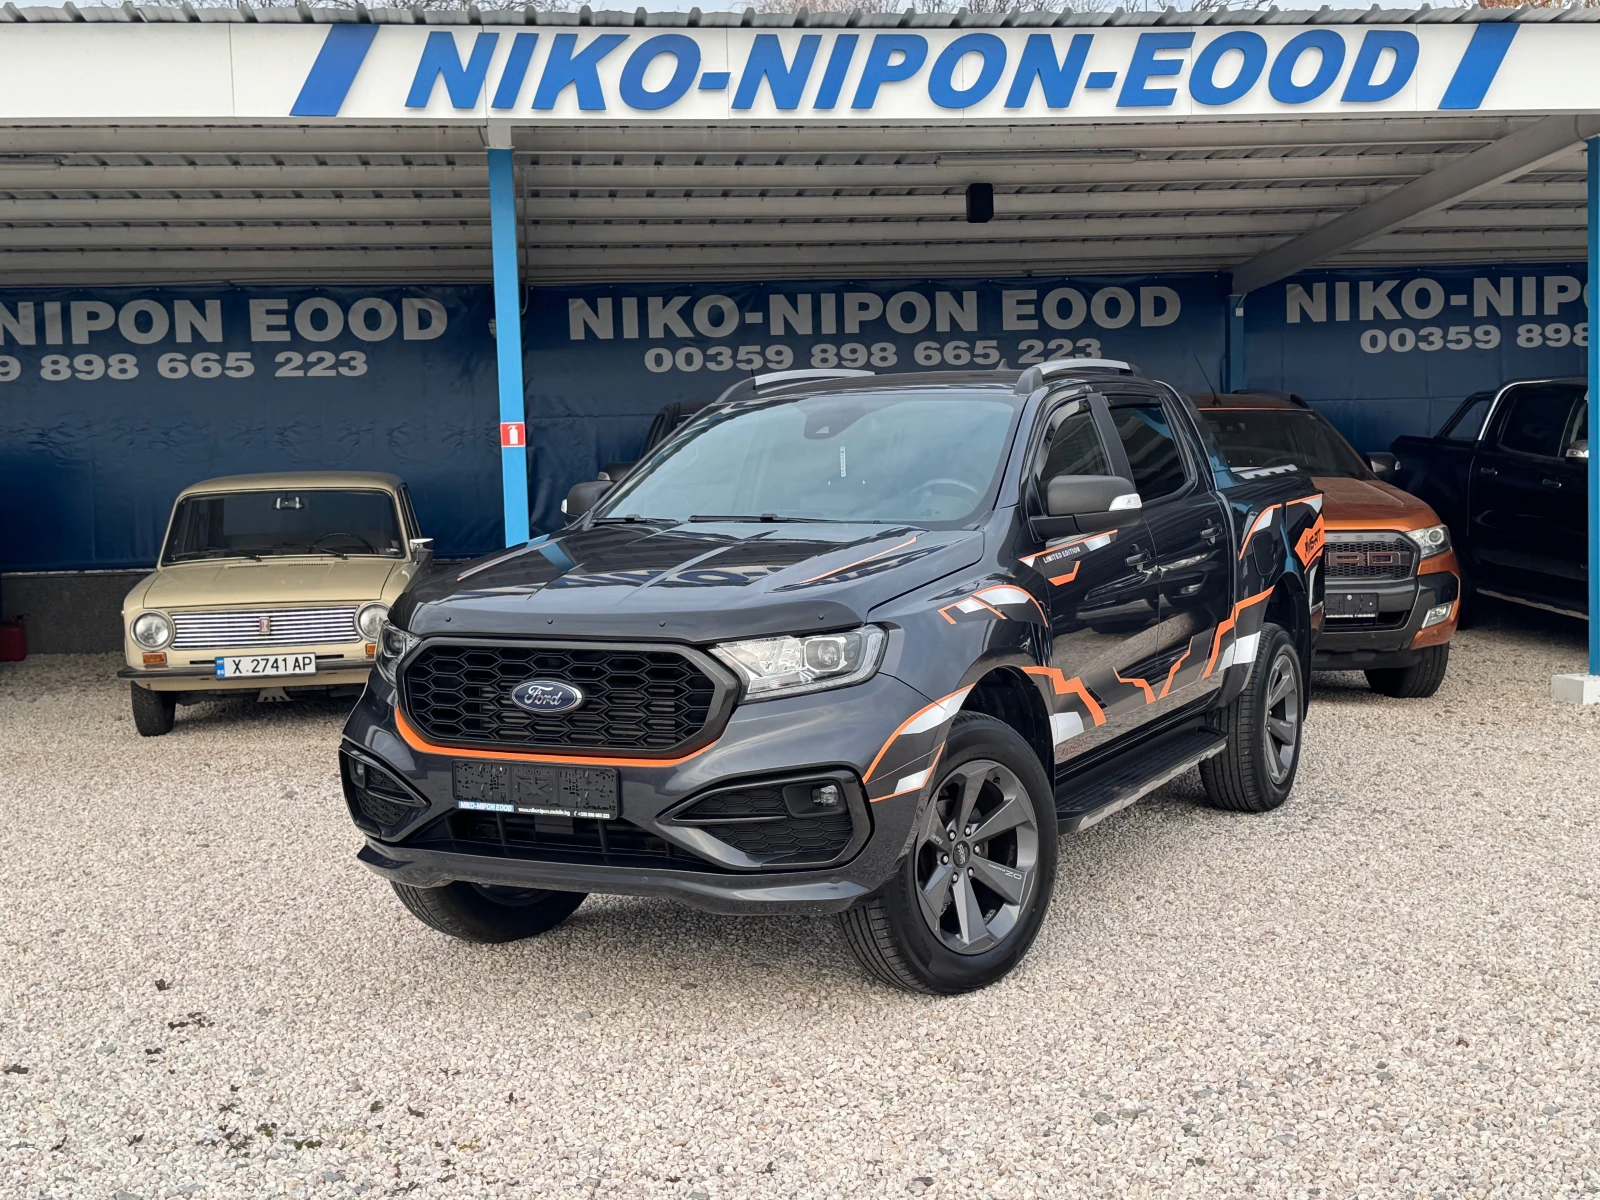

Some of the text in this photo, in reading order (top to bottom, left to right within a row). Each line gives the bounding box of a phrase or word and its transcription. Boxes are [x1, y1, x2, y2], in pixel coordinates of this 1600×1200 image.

[404, 29, 1421, 111] NIKO-NIPON-EOOD
[568, 286, 1181, 340] NIKO-NIPON EOOD
[1286, 276, 1588, 323] NIKO-NIP
[249, 297, 448, 342] EOOD
[1360, 324, 1501, 354] 00359
[40, 354, 139, 381] 898
[157, 352, 255, 379] 665
[274, 351, 368, 378] 223
[644, 338, 1102, 373] 00359 898 665 223
[1042, 546, 1081, 564] LIMITED EDITION
[232, 659, 242, 674] X
[251, 657, 287, 673] 2741
[293, 656, 312, 671] AP
[524, 685, 562, 706] Ford
